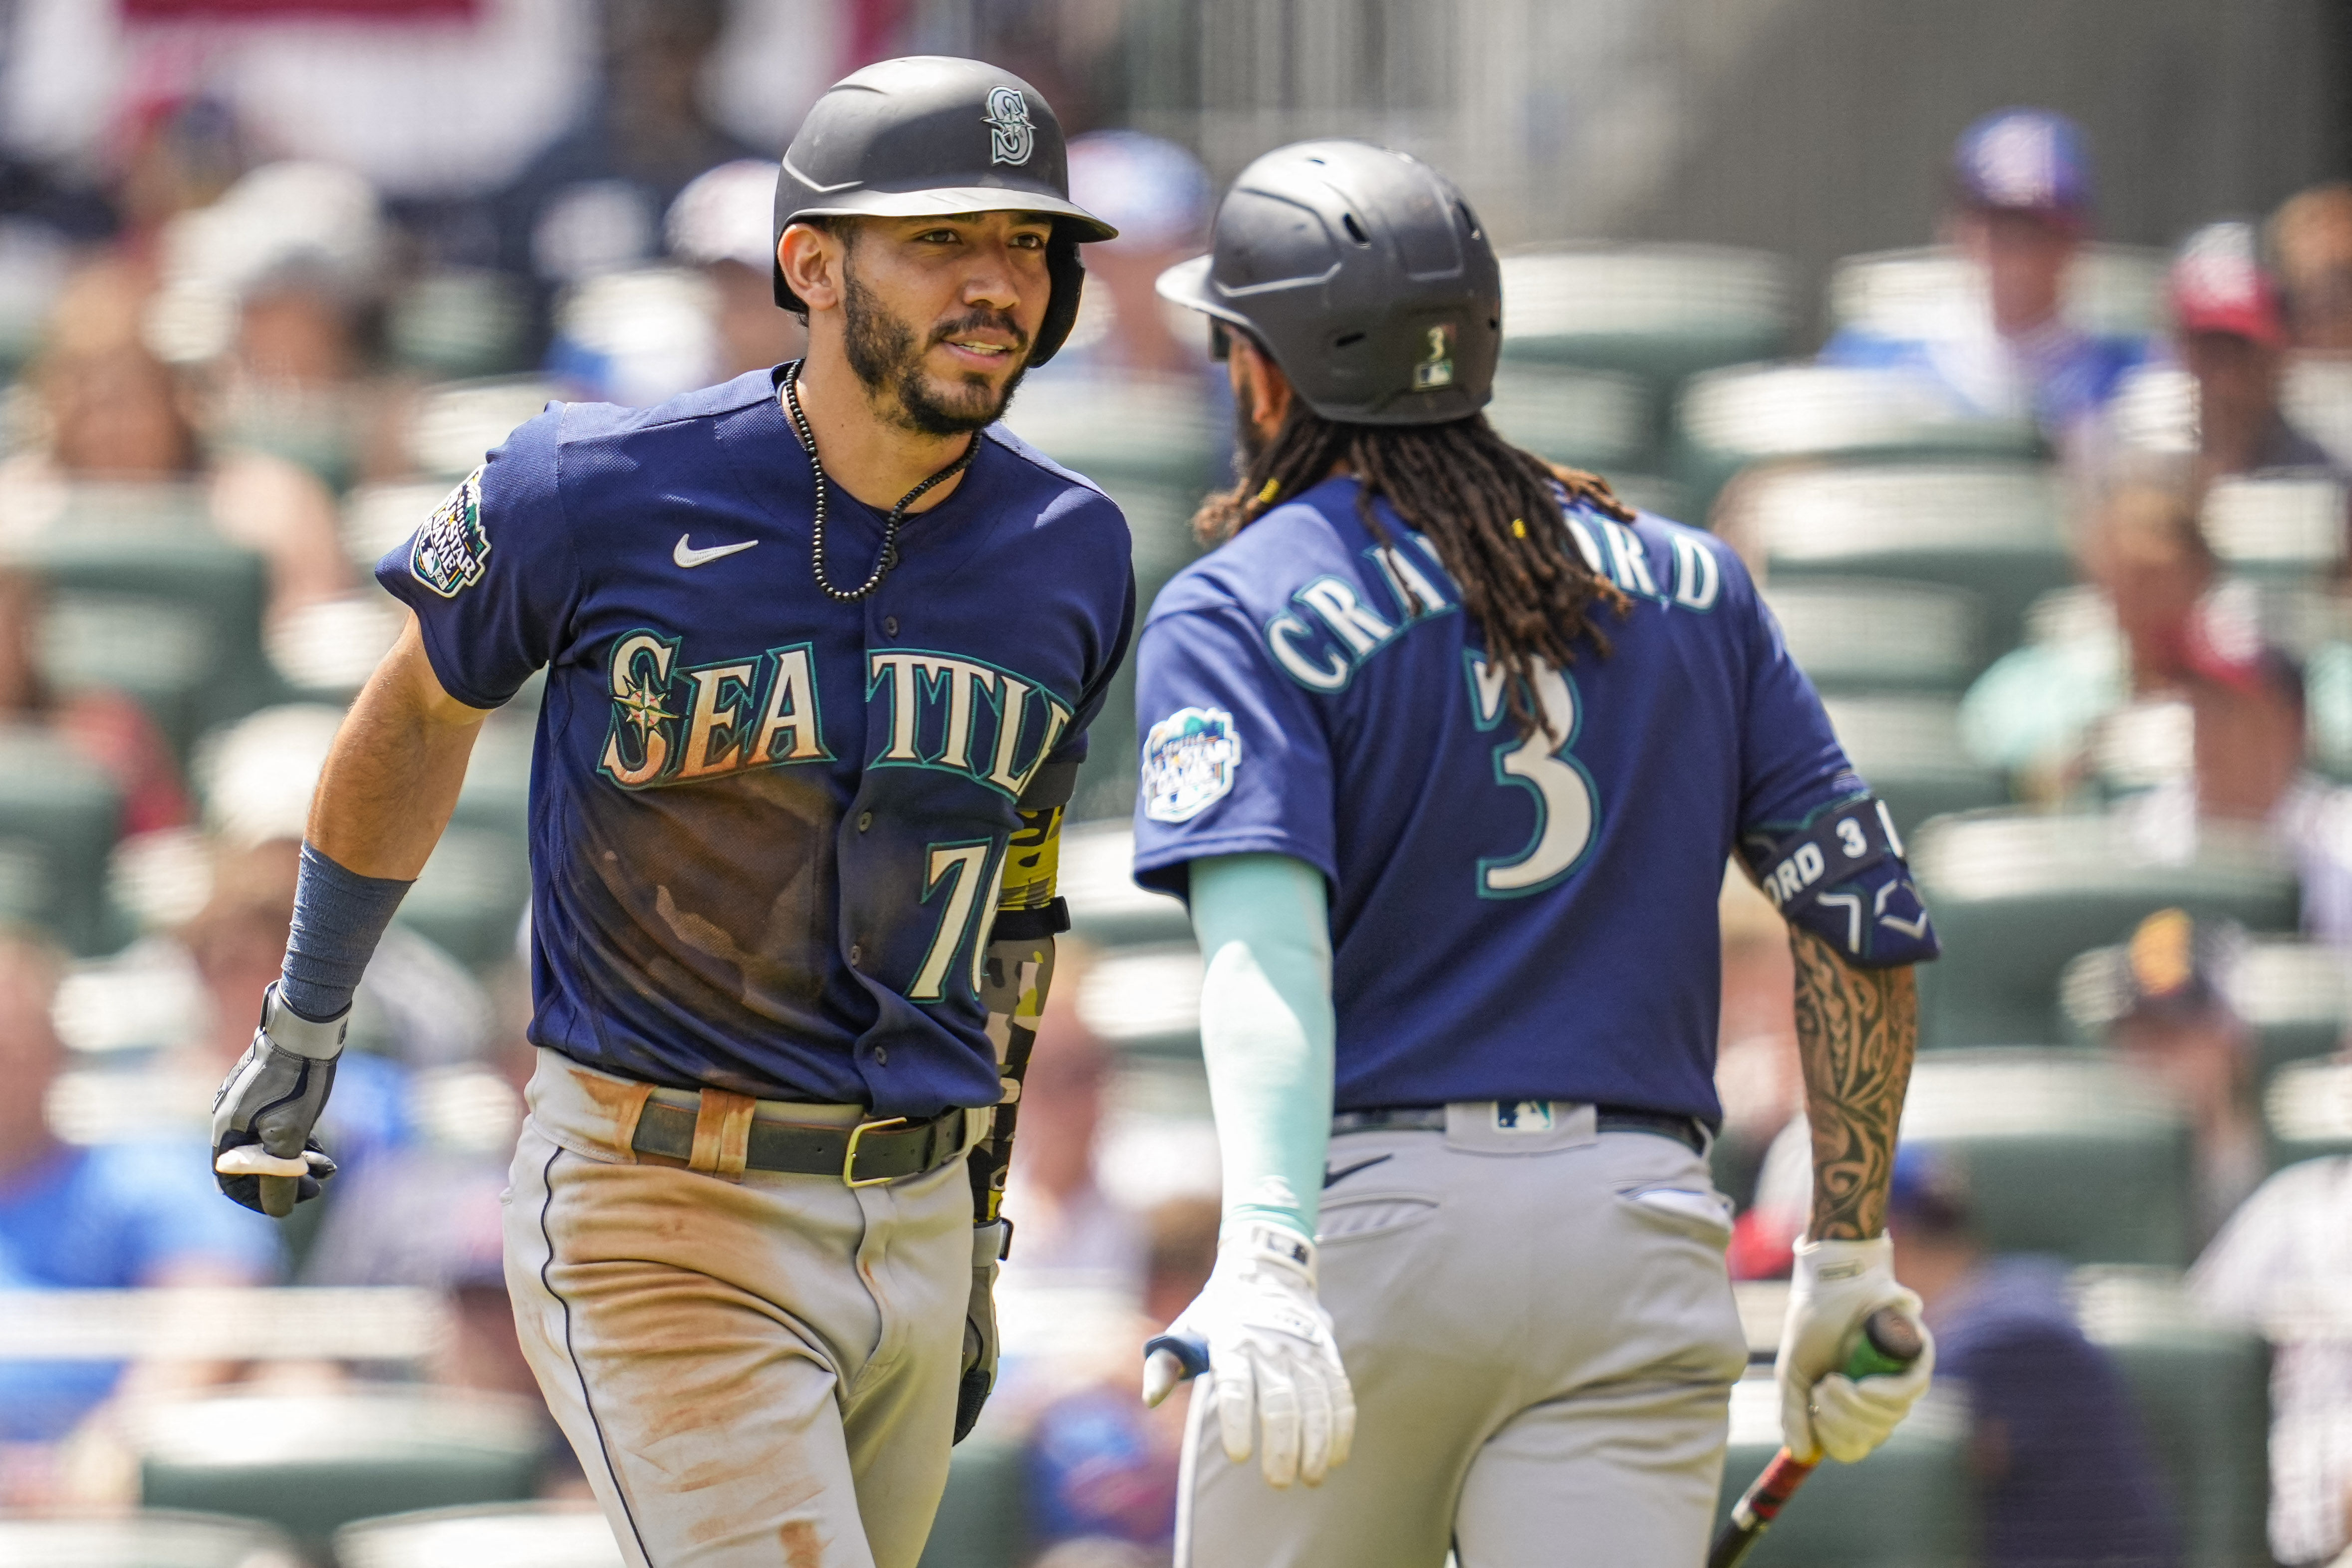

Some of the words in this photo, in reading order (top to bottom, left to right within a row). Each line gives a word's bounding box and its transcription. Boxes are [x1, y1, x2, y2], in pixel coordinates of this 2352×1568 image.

[1427, 327, 1445, 361] 3
[432, 510, 456, 574] GAME
[446, 521, 476, 579] STAR
[437, 572, 445, 584] 23
[1263, 513, 1722, 694] CRARD
[1464, 648, 1601, 899] 3
[1835, 816, 1867, 858] 3
